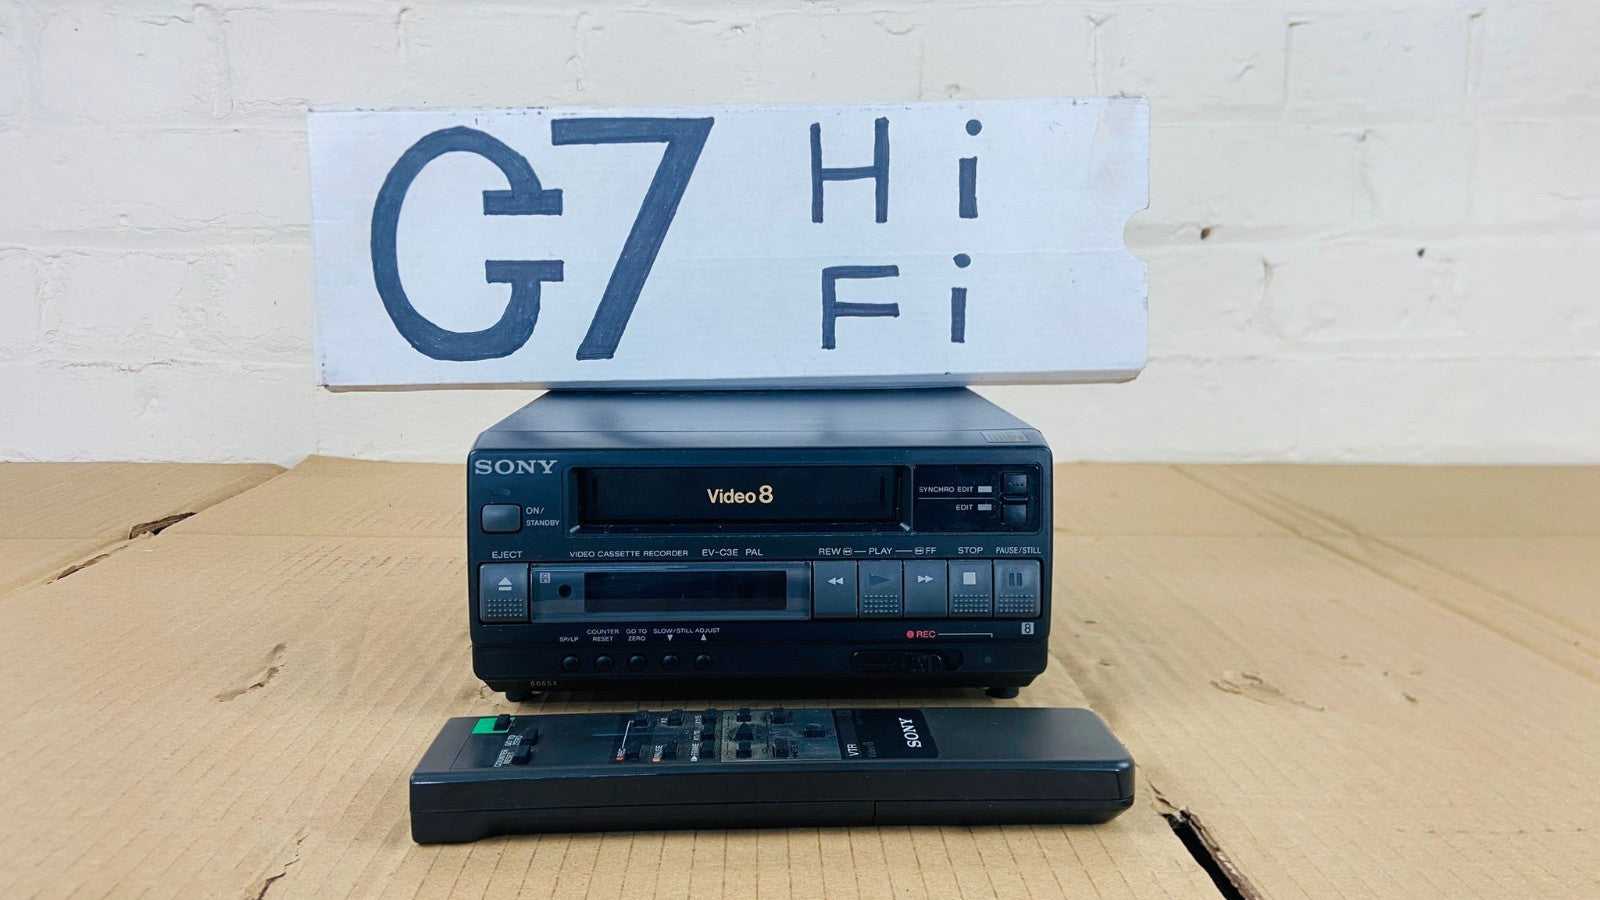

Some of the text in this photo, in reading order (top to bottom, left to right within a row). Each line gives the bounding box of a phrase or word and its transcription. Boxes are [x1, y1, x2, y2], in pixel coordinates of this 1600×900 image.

[370, 116, 714, 361] G7
[474, 459, 557, 475] SONY
[918, 485, 974, 493] SYNCHRO EDIT
[525, 506, 545, 515] ON/
[955, 503, 974, 511] EDIT
[526, 519, 560, 527] STANDBY
[491, 550, 523, 559] EJECT
[569, 549, 689, 558] VIDEO CASSETTE RECORDER
[701, 548, 764, 557] EV-C3E PAL
[818, 547, 842, 556] REW
[868, 547, 893, 555] PLAY
[925, 546, 937, 555] FF
[957, 546, 984, 555] STOP
[995, 546, 1042, 555] PAUSE/STILL
[653, 627, 694, 635] SLOW/STILL
[916, 630, 936, 639] REC
[898, 717, 923, 748] SONY
[846, 743, 859, 757] VTR
